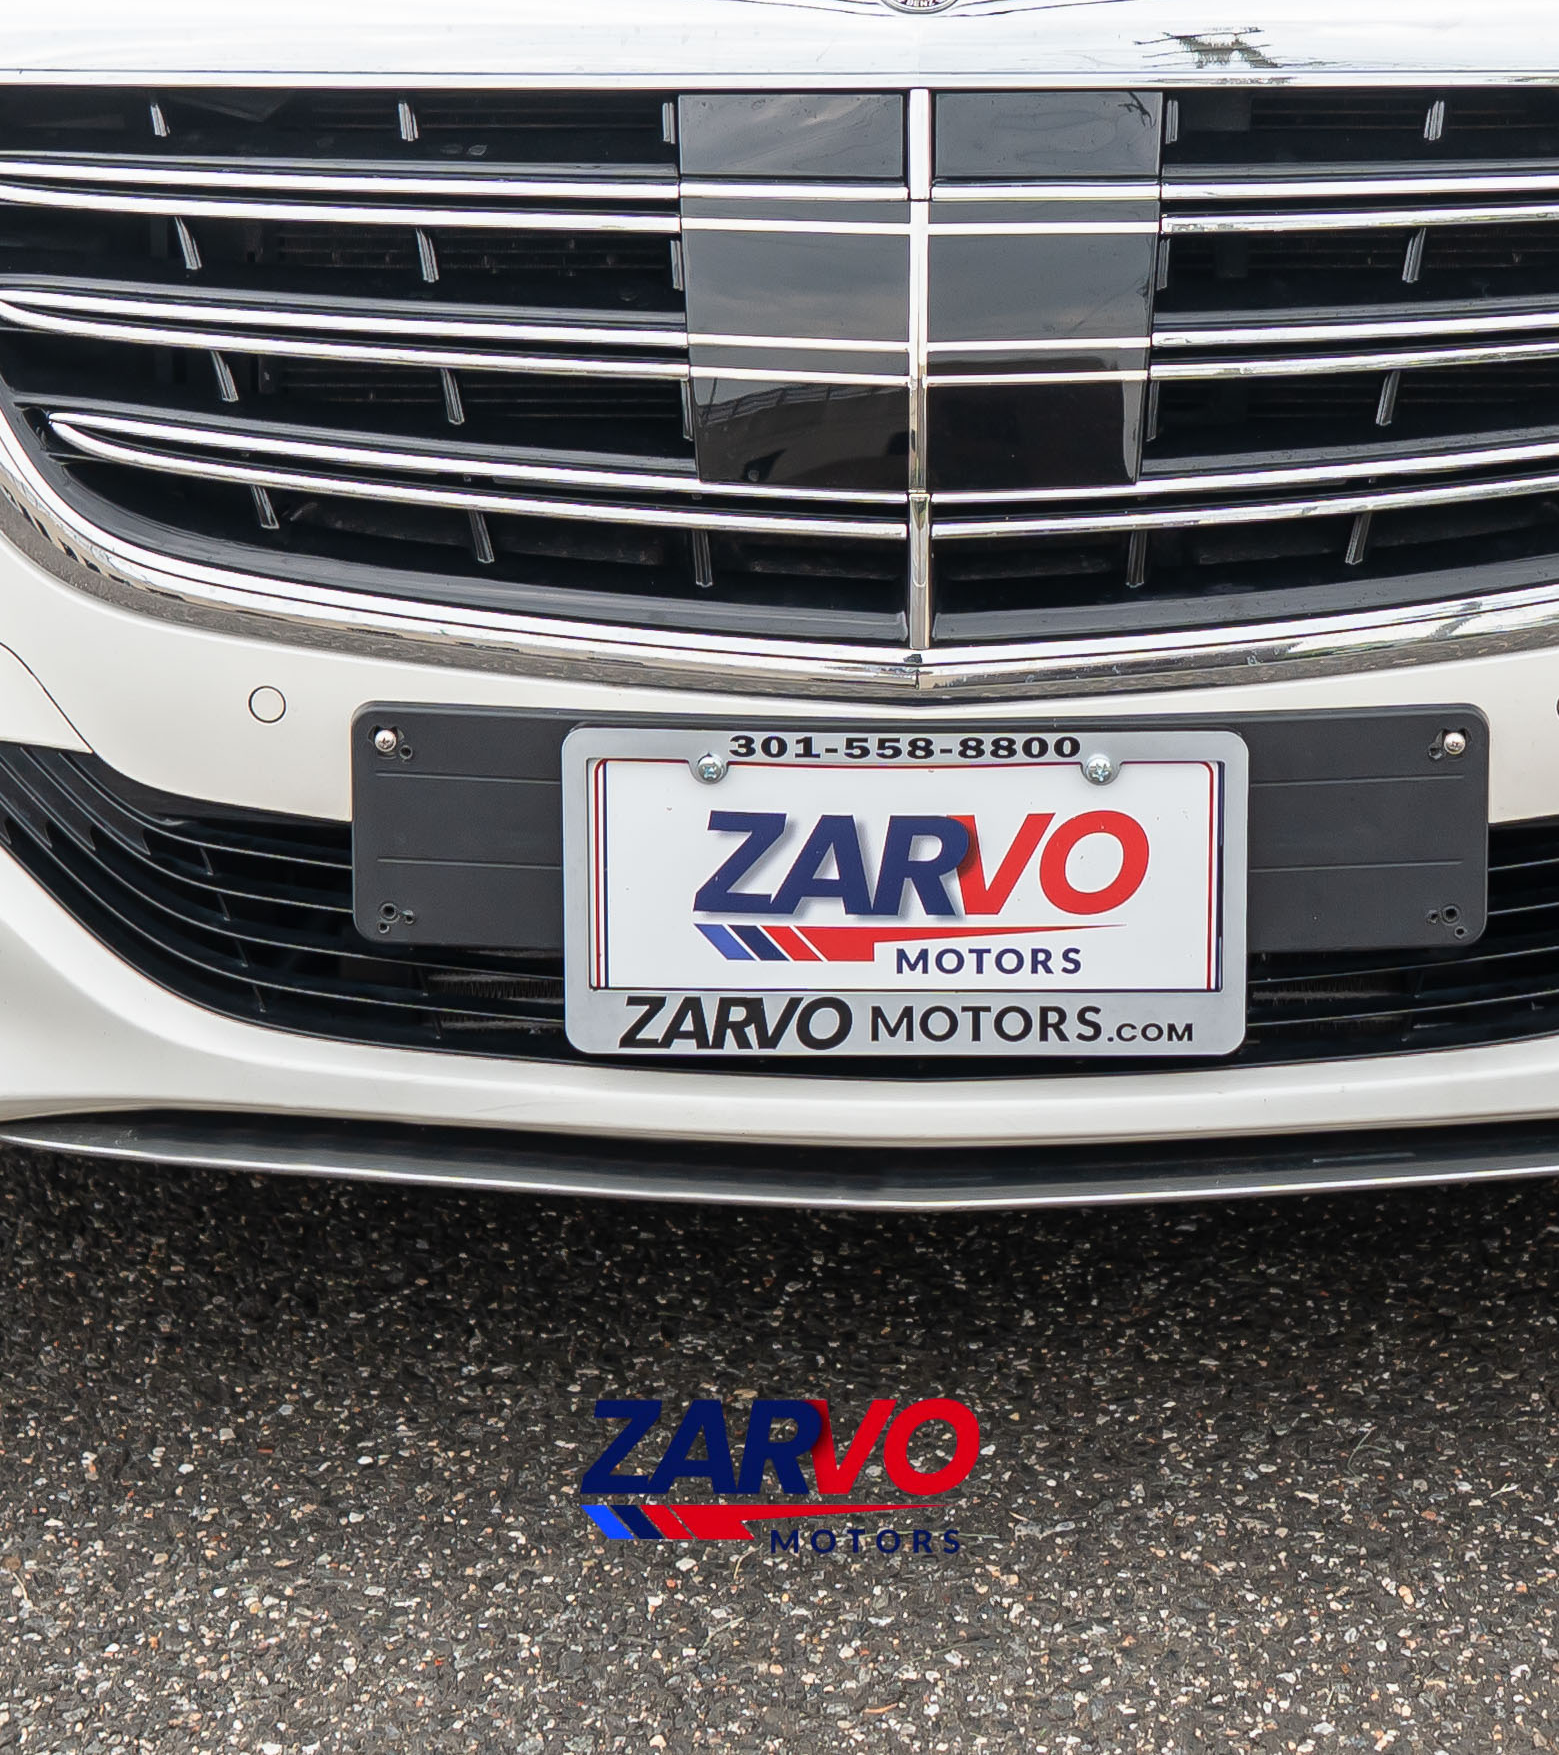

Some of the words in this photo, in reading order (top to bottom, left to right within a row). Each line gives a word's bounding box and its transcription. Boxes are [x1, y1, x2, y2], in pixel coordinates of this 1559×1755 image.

[729, 735, 1082, 760] 301-558-8800
[693, 810, 1150, 916] ZARVO
[896, 947, 1082, 975] MOTORS
[618, 995, 853, 1050] ZARVO
